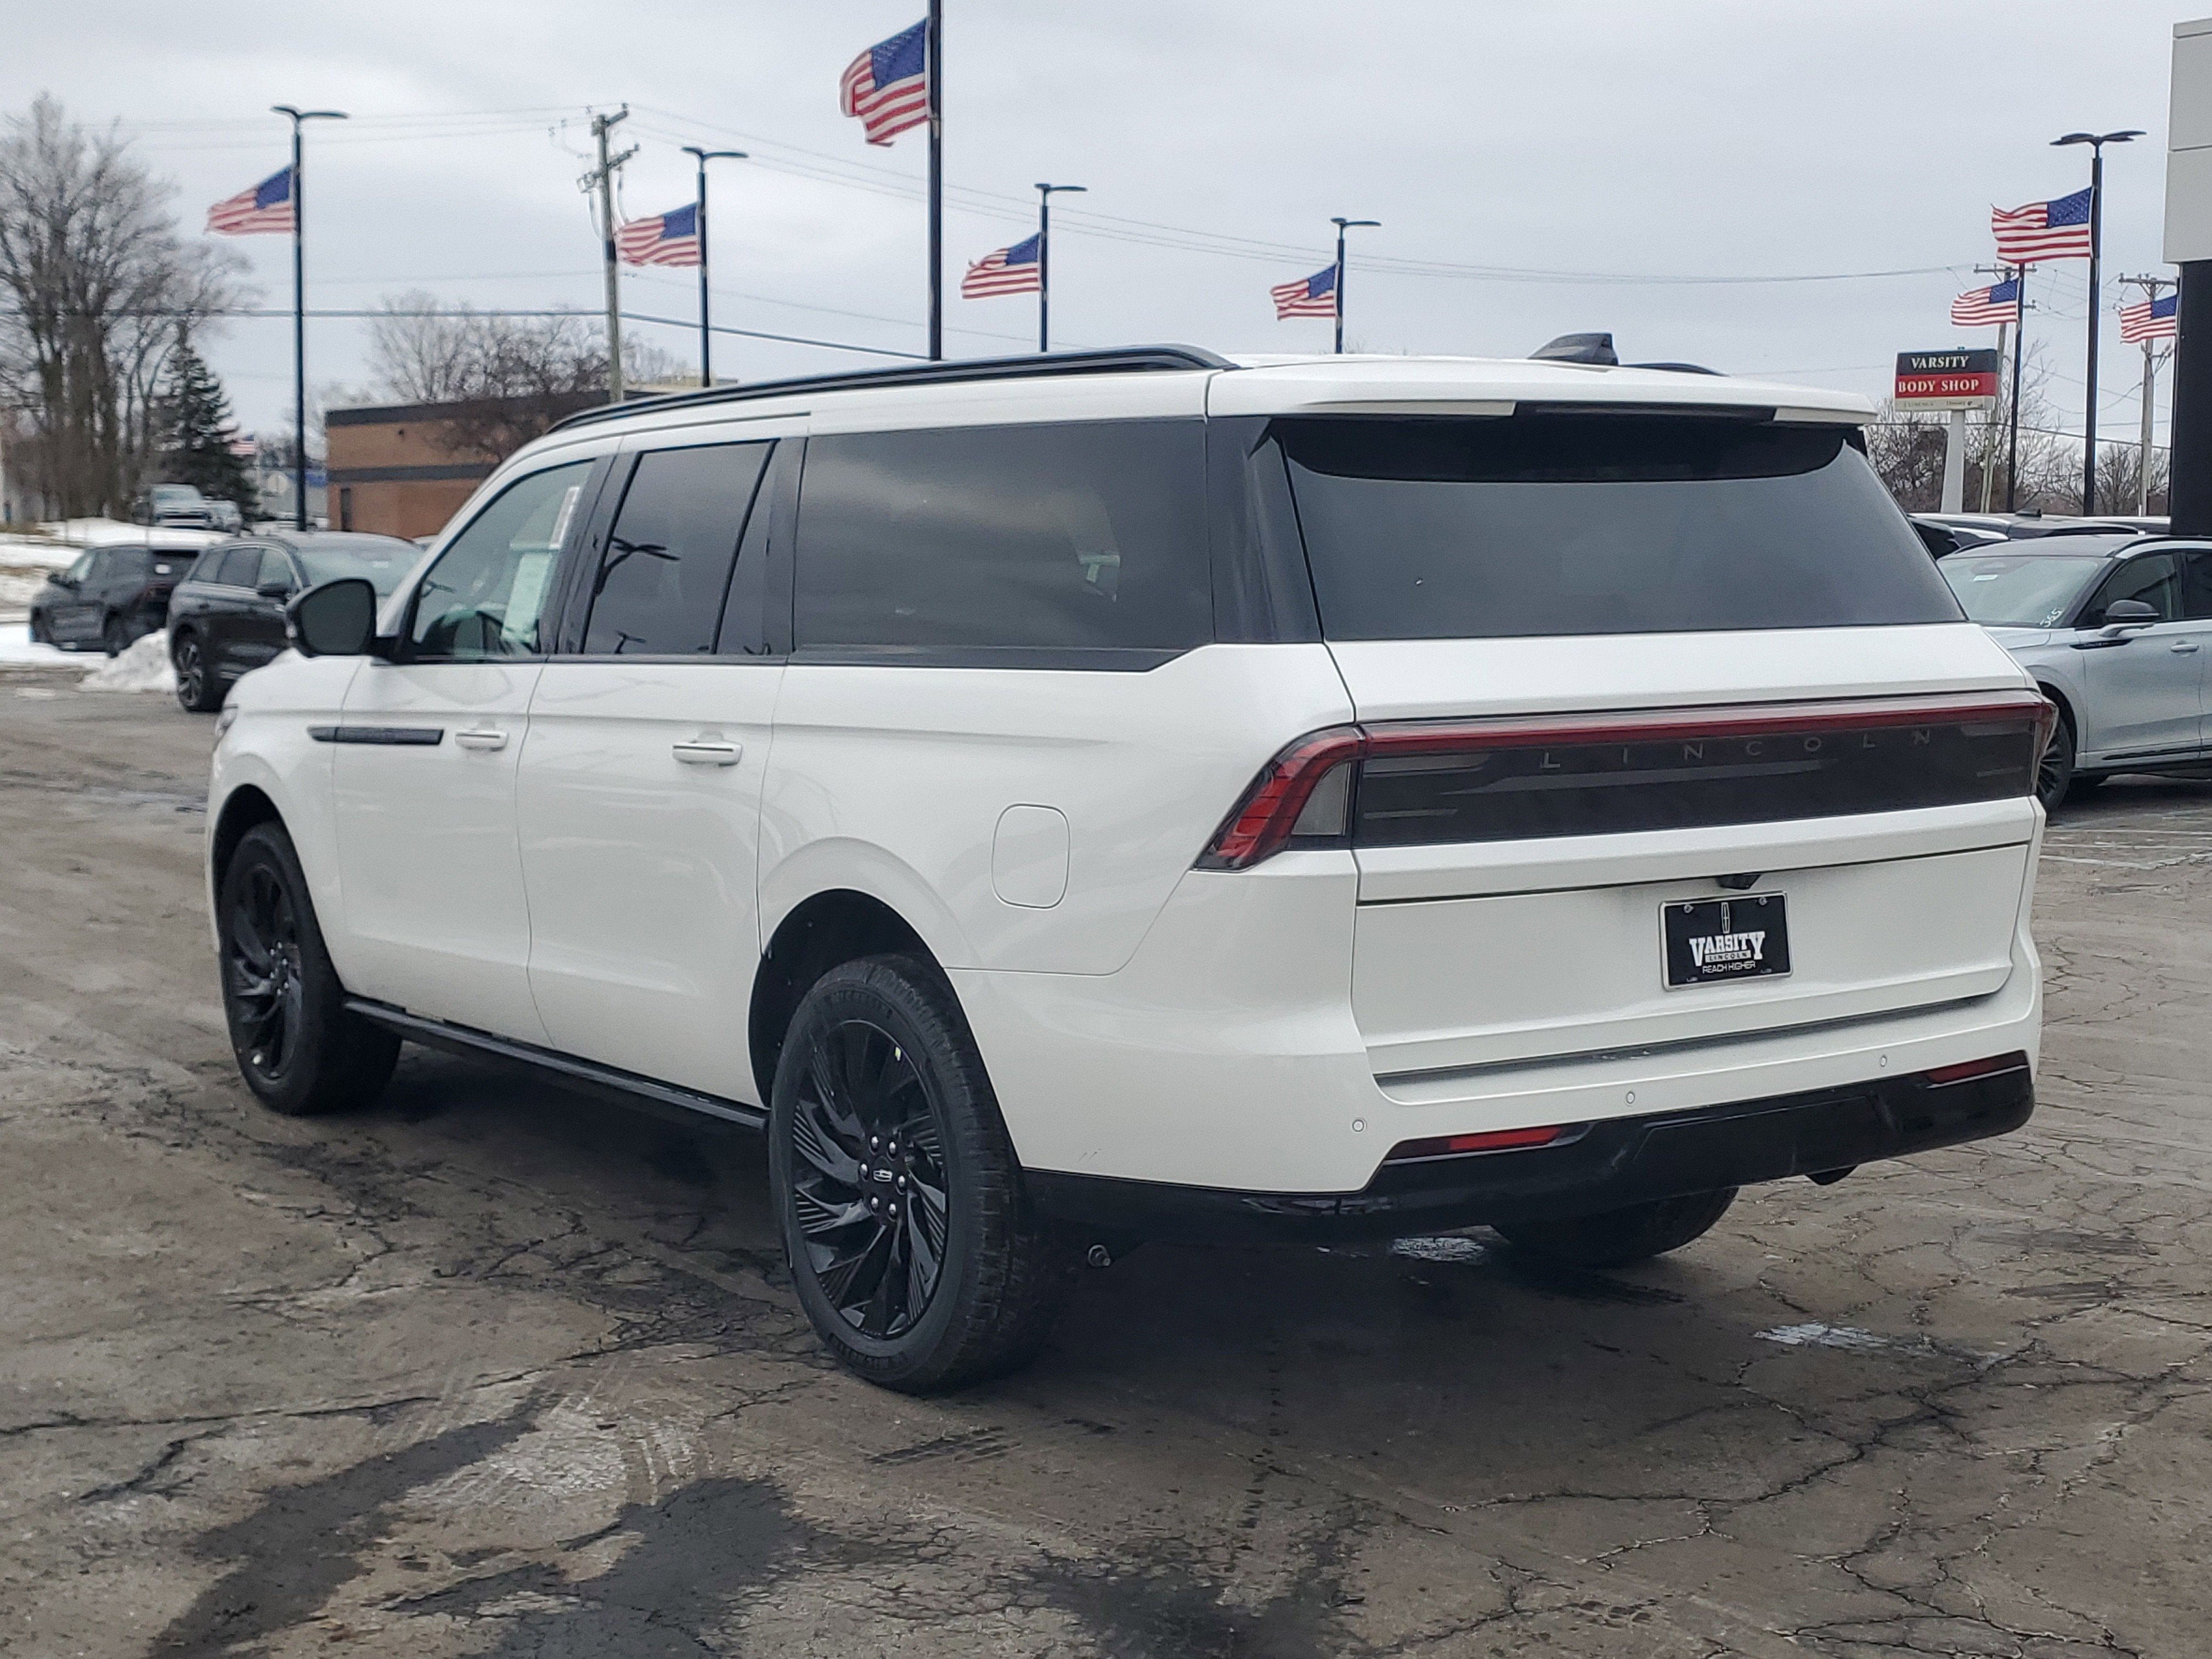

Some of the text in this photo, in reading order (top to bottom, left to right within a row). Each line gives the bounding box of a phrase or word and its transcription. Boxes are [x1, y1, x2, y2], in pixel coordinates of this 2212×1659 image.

[1911, 356, 1970, 370] VARSITY
[1898, 379, 1979, 392] BODY SHOP
[1539, 730, 1931, 768] LINCOLN
[1689, 931, 1765, 967] VARSITY
[1708, 952, 1748, 961] LINCOLN
[1702, 960, 1756, 974] REACH HIGHER
